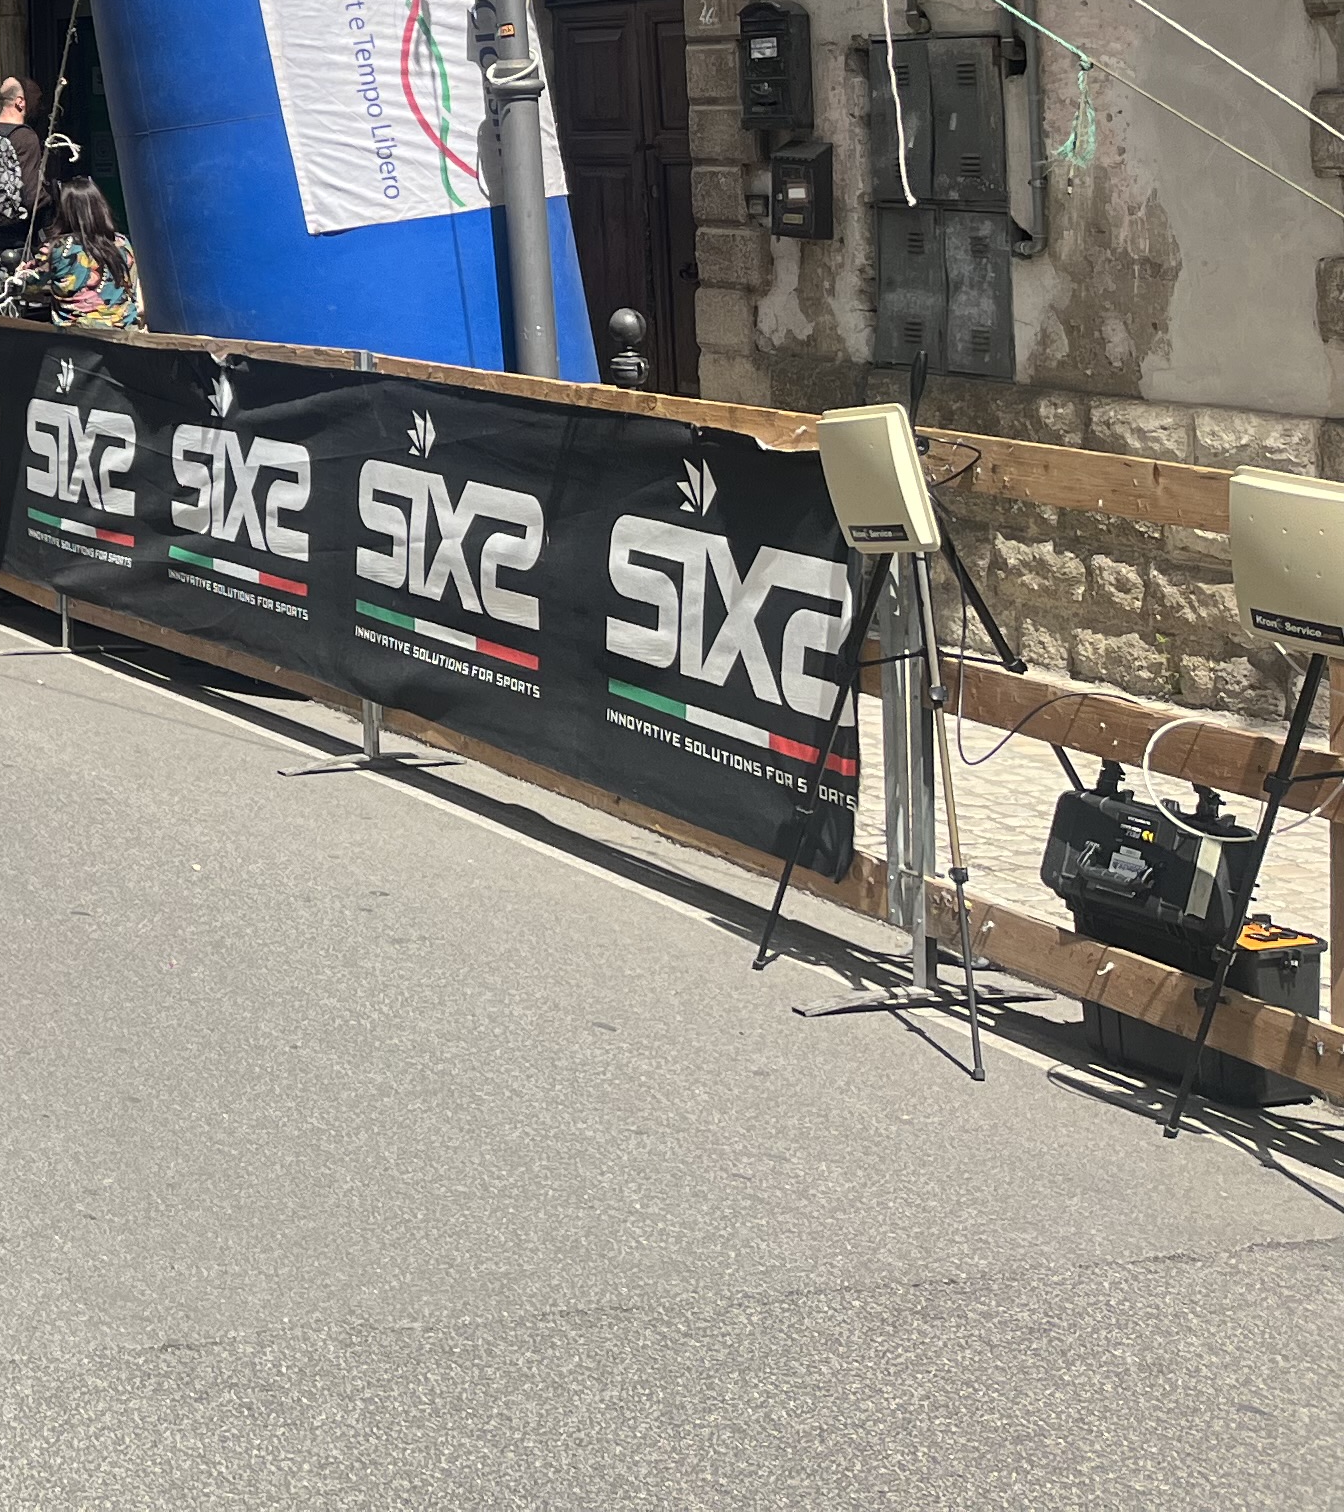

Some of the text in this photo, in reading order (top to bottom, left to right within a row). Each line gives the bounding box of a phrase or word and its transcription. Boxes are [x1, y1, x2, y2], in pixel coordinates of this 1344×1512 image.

[352, 16, 366, 30] e
[354, 33, 389, 120] Tempo
[370, 122, 401, 201] Libero
[107, 552, 133, 569] SPORTS
[167, 568, 309, 622] INNOVATIVE SOLUTIONS FOR SPORTS
[1255, 614, 1278, 629] Kron
[1284, 621, 1322, 638] Service
[355, 624, 541, 699] INNOVATIVE SOLUTIONS FOR SPORTS
[606, 707, 857, 811] INNOVATIVE SOLUTIONS FOR SORTS
